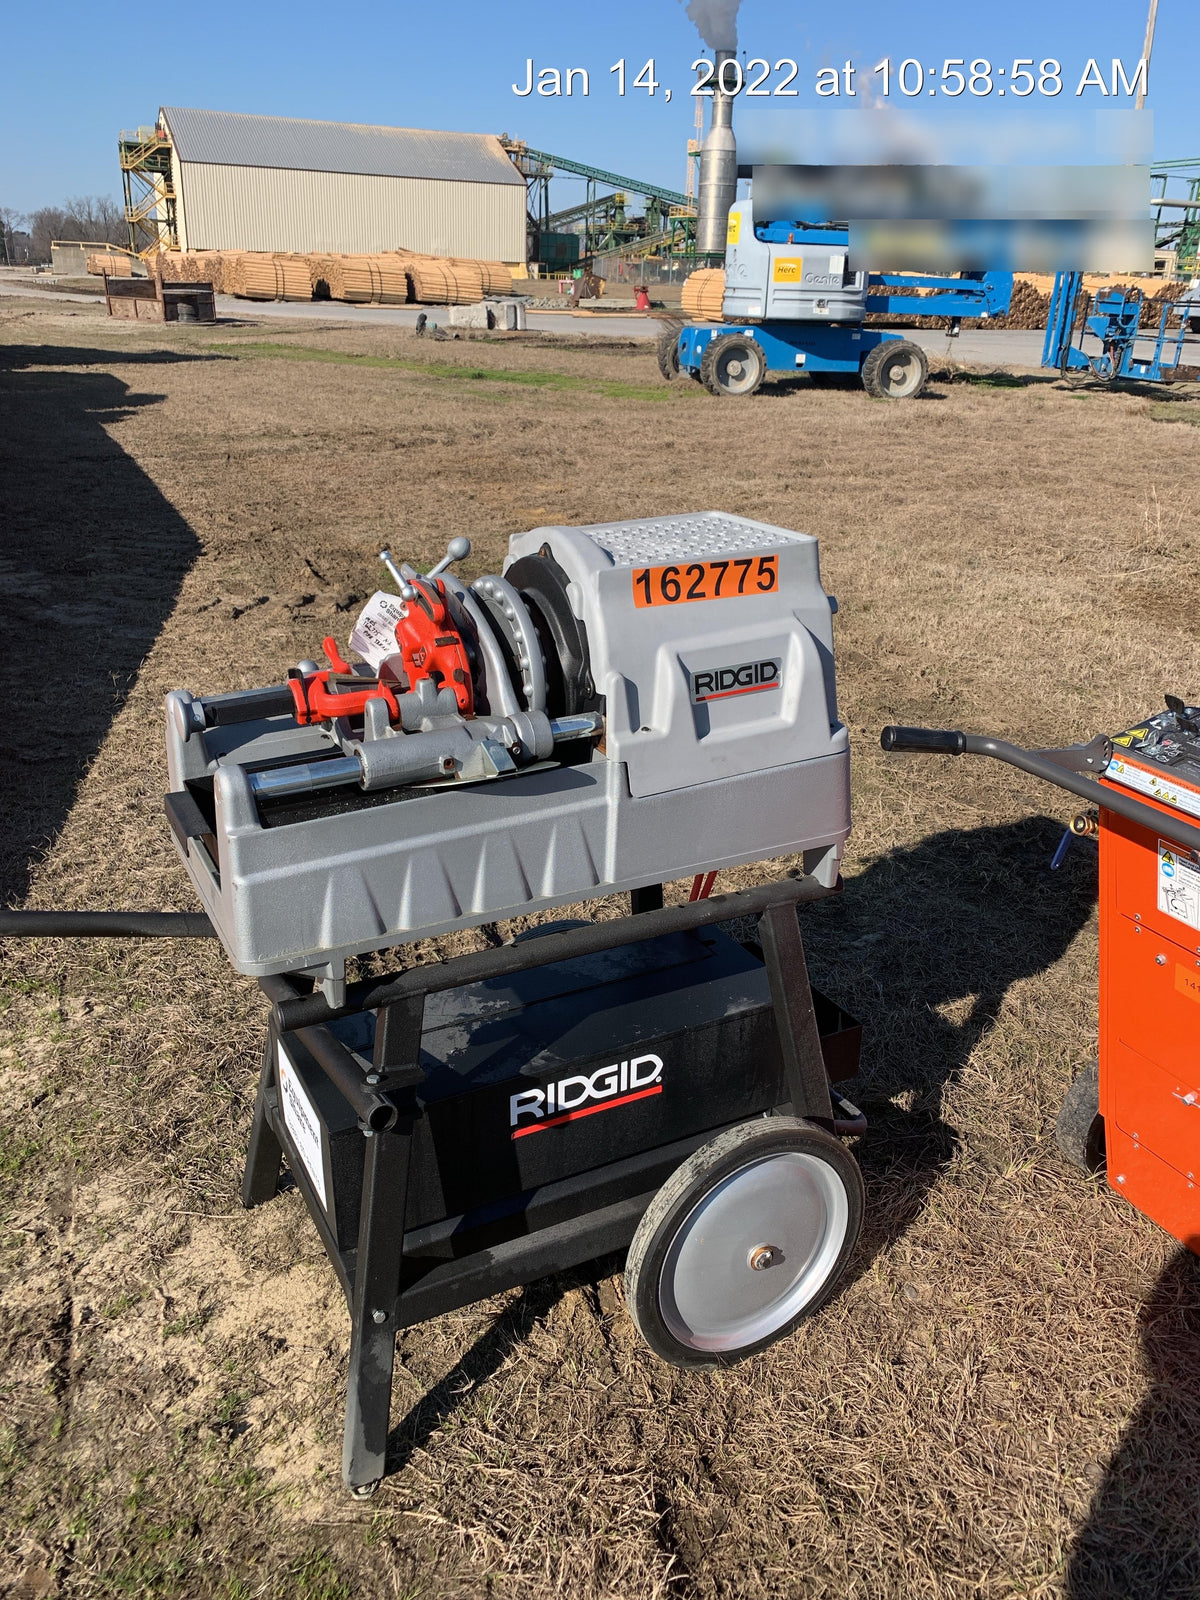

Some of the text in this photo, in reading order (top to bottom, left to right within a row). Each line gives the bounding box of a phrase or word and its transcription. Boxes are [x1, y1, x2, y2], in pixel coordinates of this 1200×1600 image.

[777, 265, 796, 274] Herc
[804, 272, 840, 286] Genie
[636, 555, 776, 605] 162775
[694, 661, 779, 695] RIDGID
[510, 1053, 664, 1127] RIDGID
